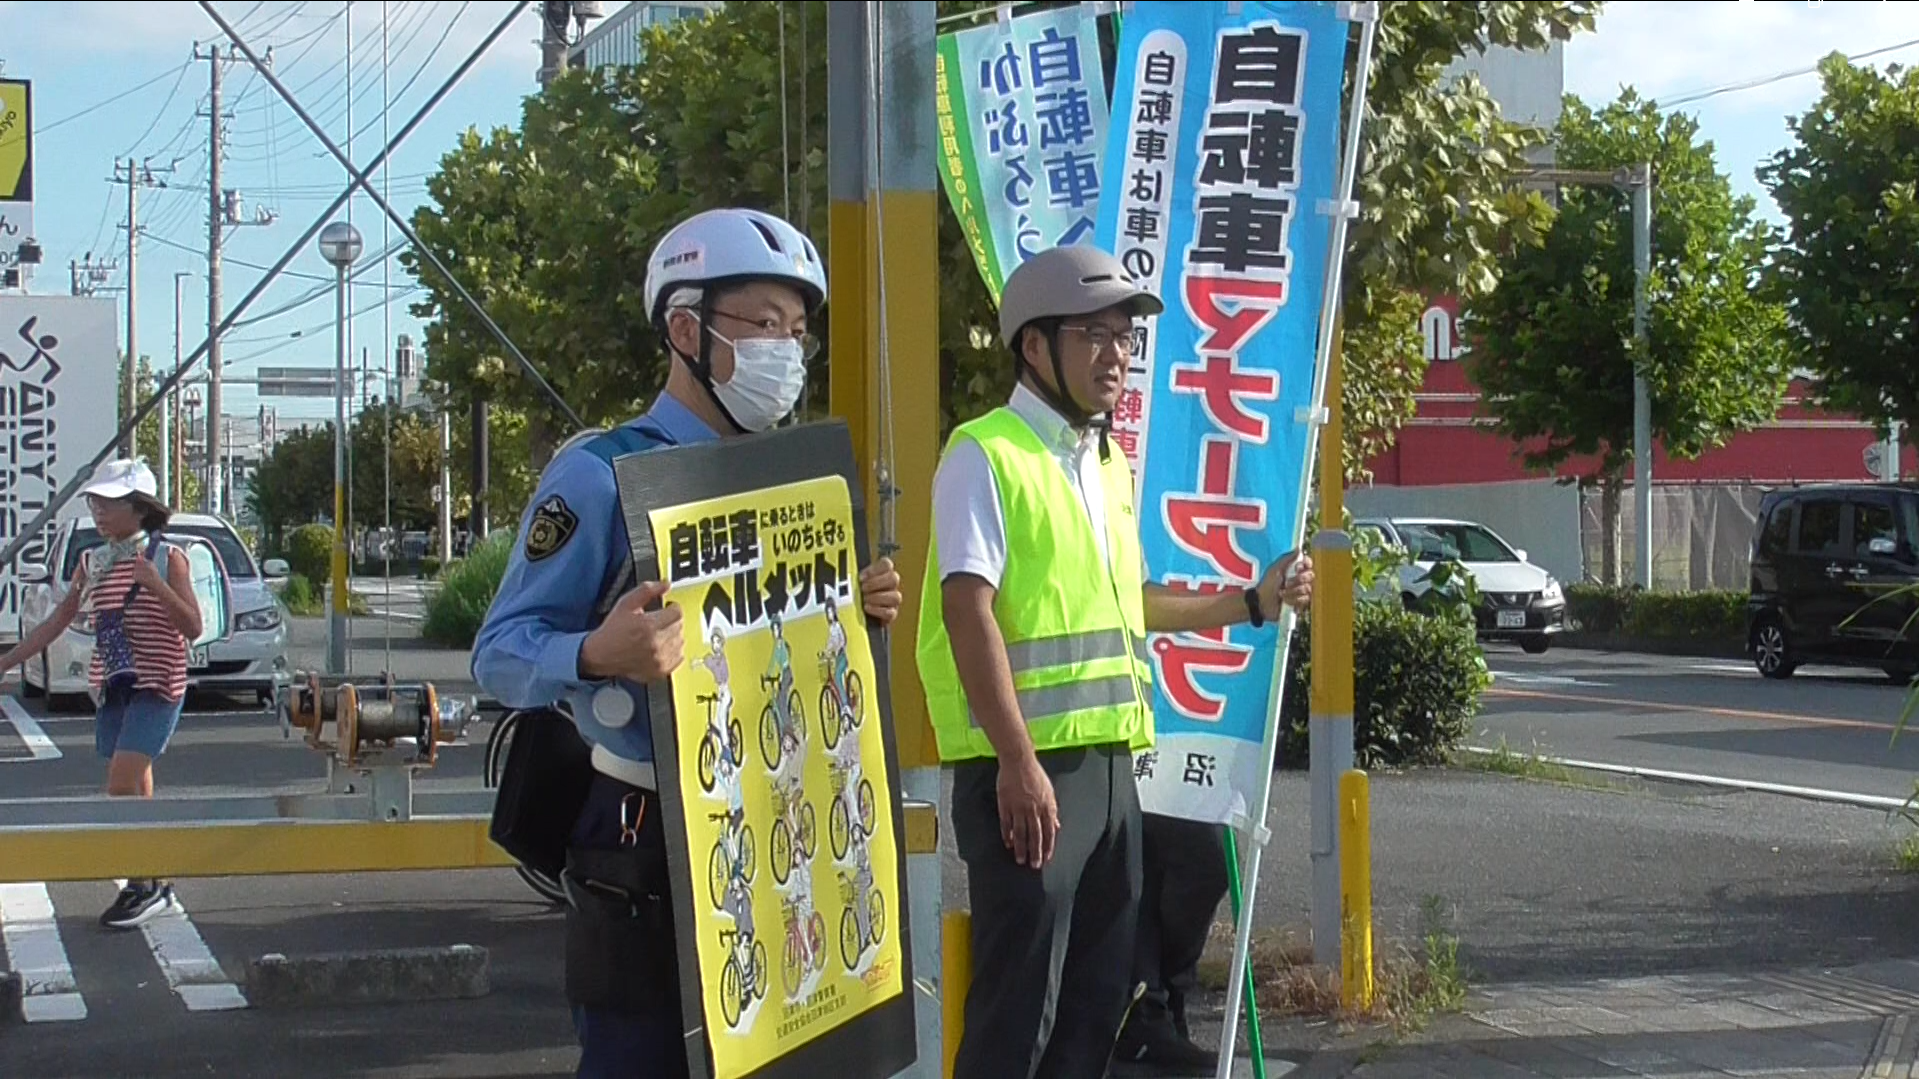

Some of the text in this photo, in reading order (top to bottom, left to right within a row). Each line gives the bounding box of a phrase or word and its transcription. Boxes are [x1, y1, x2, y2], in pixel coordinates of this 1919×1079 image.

[759, 502, 815, 530] に乗るときは
[669, 509, 759, 582] 自転車
[772, 518, 846, 558] いのちを守る
